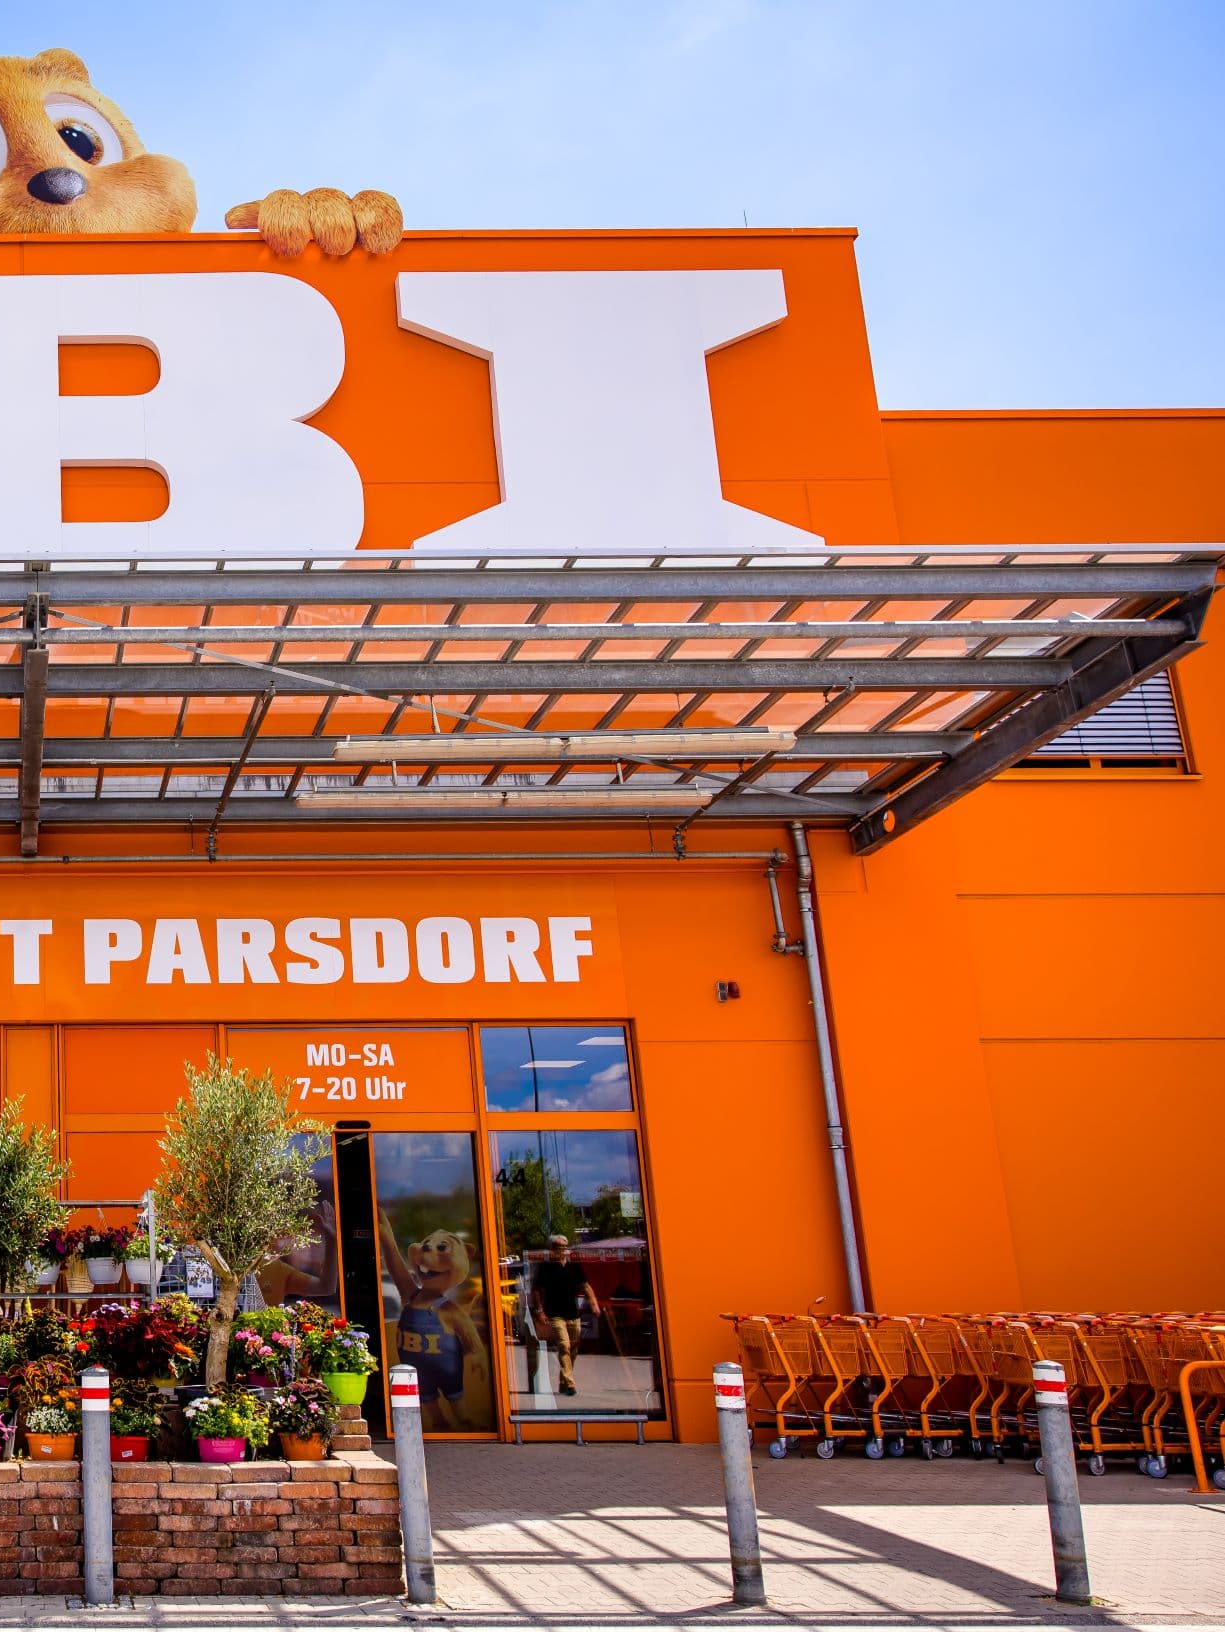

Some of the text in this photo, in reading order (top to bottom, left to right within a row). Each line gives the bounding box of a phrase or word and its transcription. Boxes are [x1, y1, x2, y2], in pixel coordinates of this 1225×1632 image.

[83, 916, 594, 985] PARSDORF
[306, 1043, 395, 1067] MO-SA
[296, 1075, 407, 1100] 7-20 Uhr
